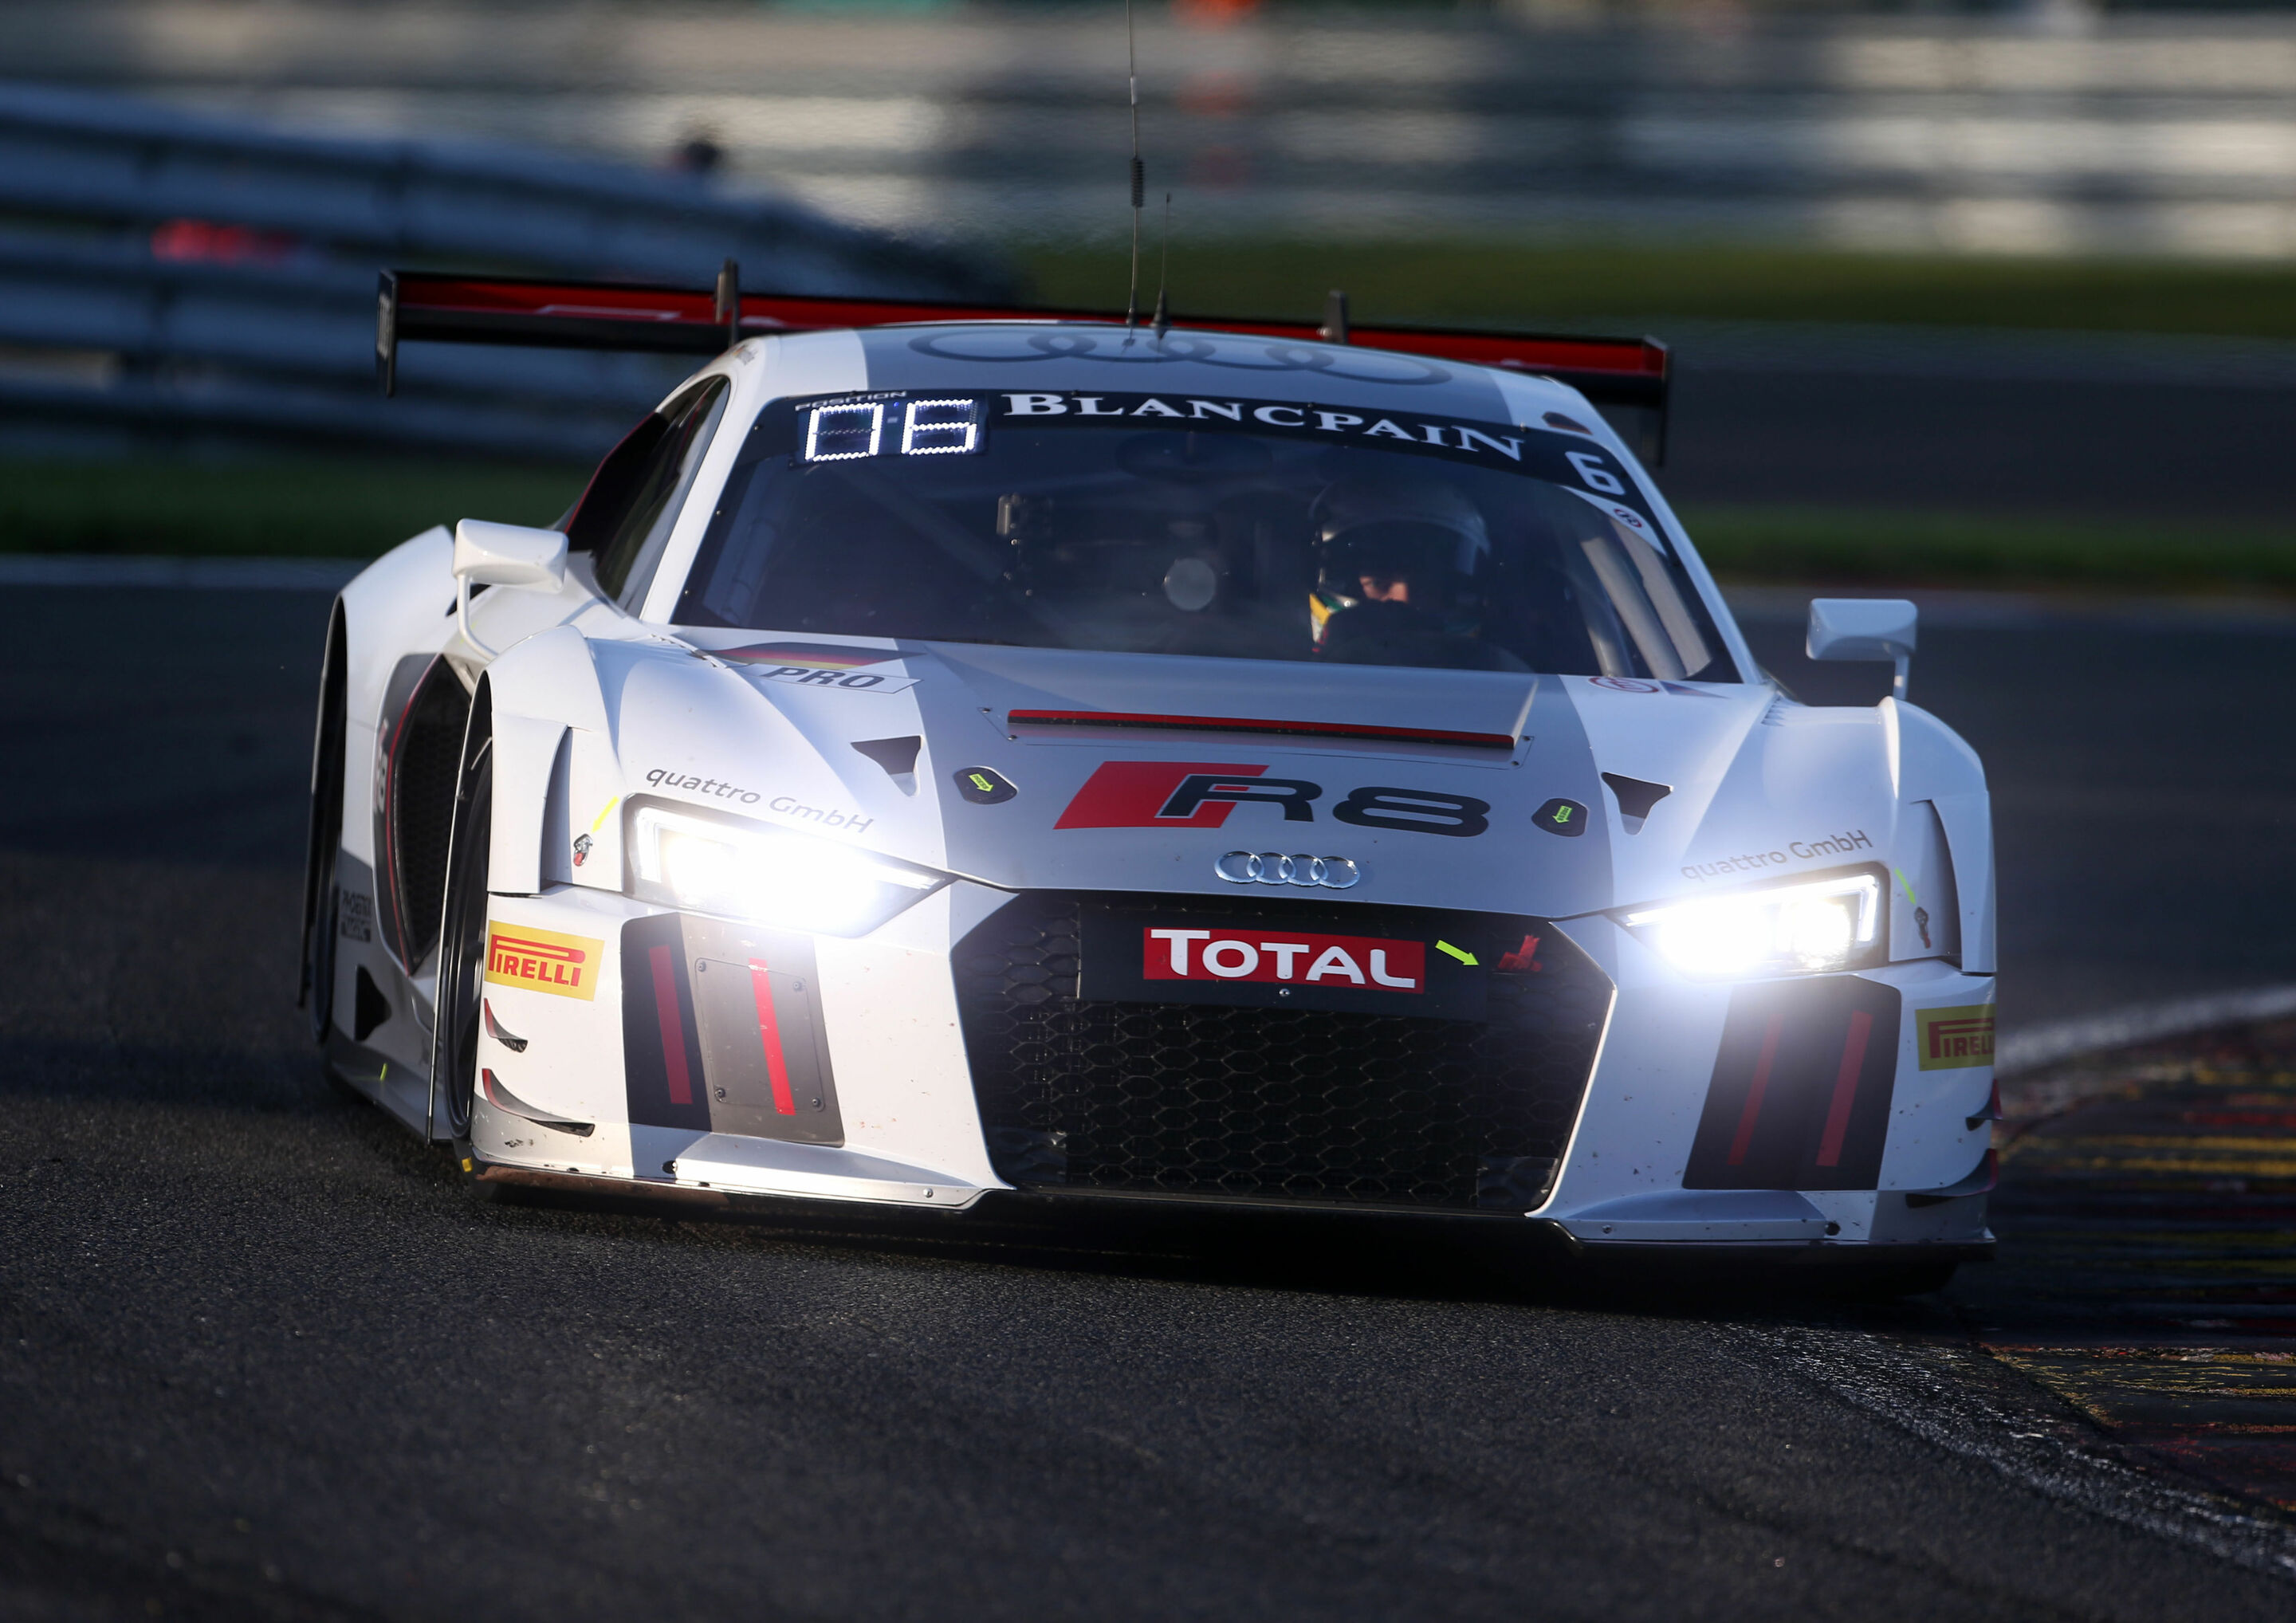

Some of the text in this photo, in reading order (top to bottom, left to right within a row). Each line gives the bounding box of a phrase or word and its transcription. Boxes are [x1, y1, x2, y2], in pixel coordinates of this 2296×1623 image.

[795, 391, 907, 411] POSITION
[1001, 394, 1524, 462] BLANCPAIN
[804, 399, 978, 462] 06
[1565, 451, 1626, 495] 6
[760, 666, 885, 689] PRO
[645, 768, 875, 834] quattro GmbH
[1159, 773, 1492, 838] R8
[1680, 829, 1873, 882] quattro GmbH
[488, 933, 587, 988] PIRELLI
[1150, 929, 1417, 989] TOTAL
